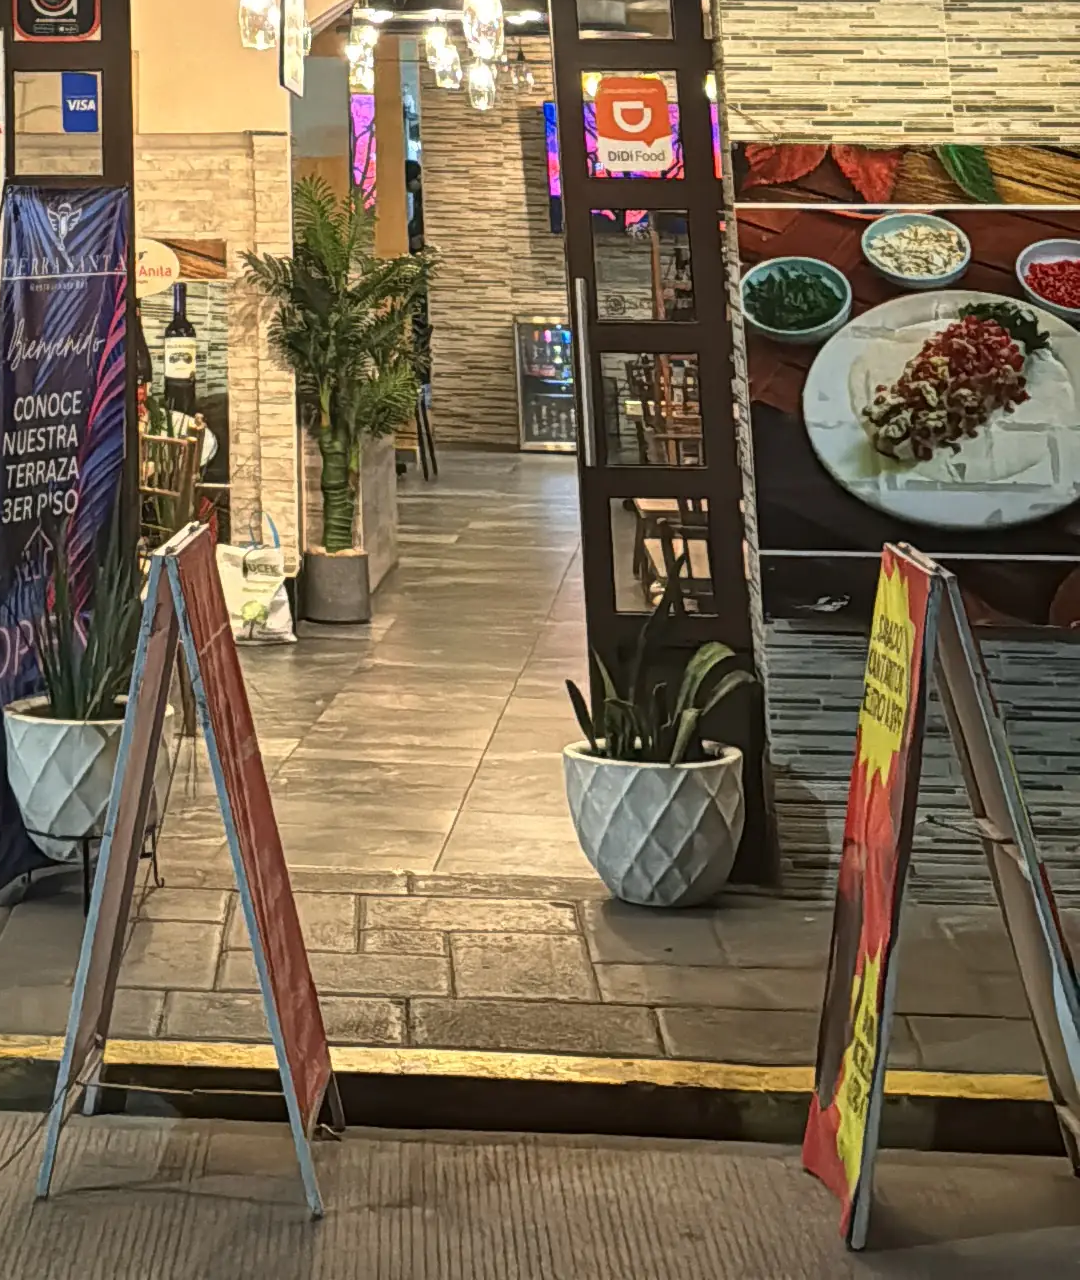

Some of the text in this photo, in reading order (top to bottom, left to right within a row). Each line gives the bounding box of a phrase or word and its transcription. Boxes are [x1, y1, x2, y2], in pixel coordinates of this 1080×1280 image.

[66, 99, 96, 112] VISA
[636, 149, 666, 162] Food
[13, 390, 83, 422] CONOCE
[2, 423, 79, 457] NUESTRA
[6, 455, 80, 490] TERRAZA
[1, 489, 79, 524] 3ER PISO
